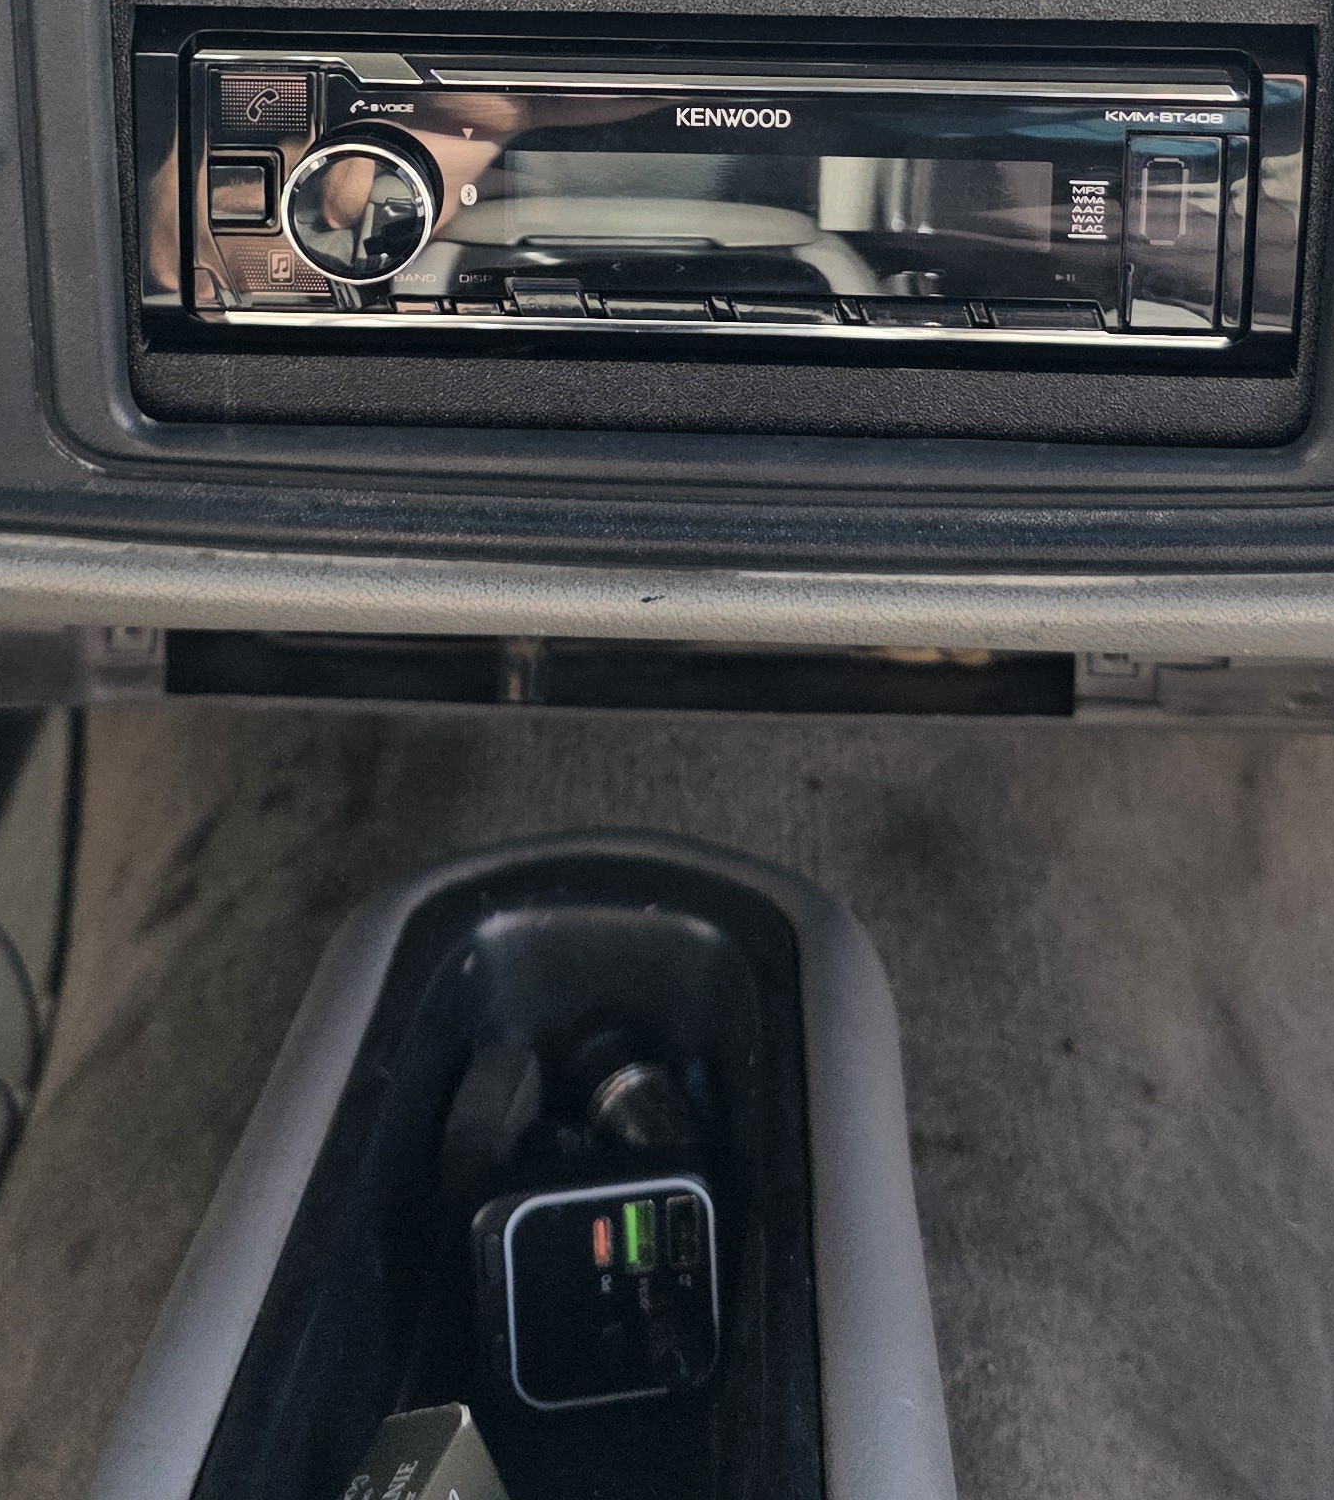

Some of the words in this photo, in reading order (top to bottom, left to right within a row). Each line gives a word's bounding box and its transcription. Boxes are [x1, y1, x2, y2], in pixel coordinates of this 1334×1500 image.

[379, 103, 415, 113] VOICE
[675, 107, 792, 130] KENWOOD
[1071, 185, 1106, 195] MP3
[1071, 195, 1105, 205] WMA
[1071, 205, 1105, 214] AAC
[1071, 214, 1104, 224] WAV
[1071, 224, 1104, 233] FLAC
[393, 273, 437, 284] BAND
[458, 273, 493, 284] DISP
